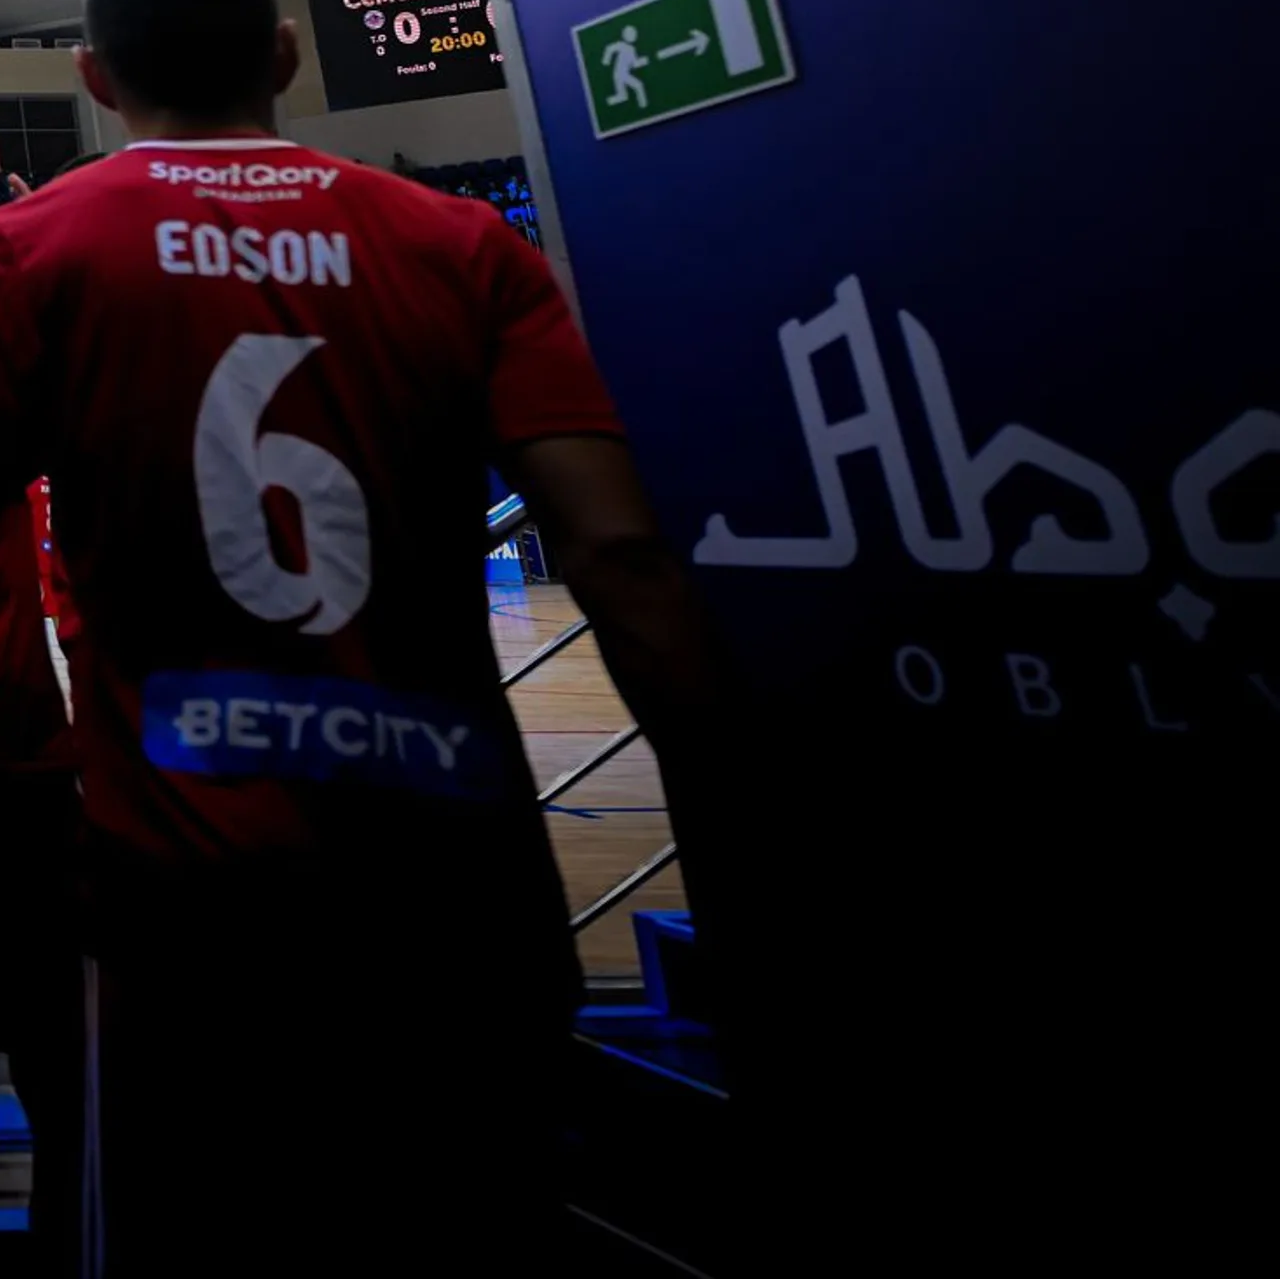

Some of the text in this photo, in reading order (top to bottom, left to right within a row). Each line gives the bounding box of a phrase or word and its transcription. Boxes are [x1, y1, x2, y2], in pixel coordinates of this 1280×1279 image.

[393, 11, 421, 44] 0
[430, 31, 486, 53] 20:00
[149, 160, 339, 190] SportQory
[155, 220, 352, 287] EDSON
[193, 333, 372, 636] 6
[172, 696, 471, 772] BETCITY
